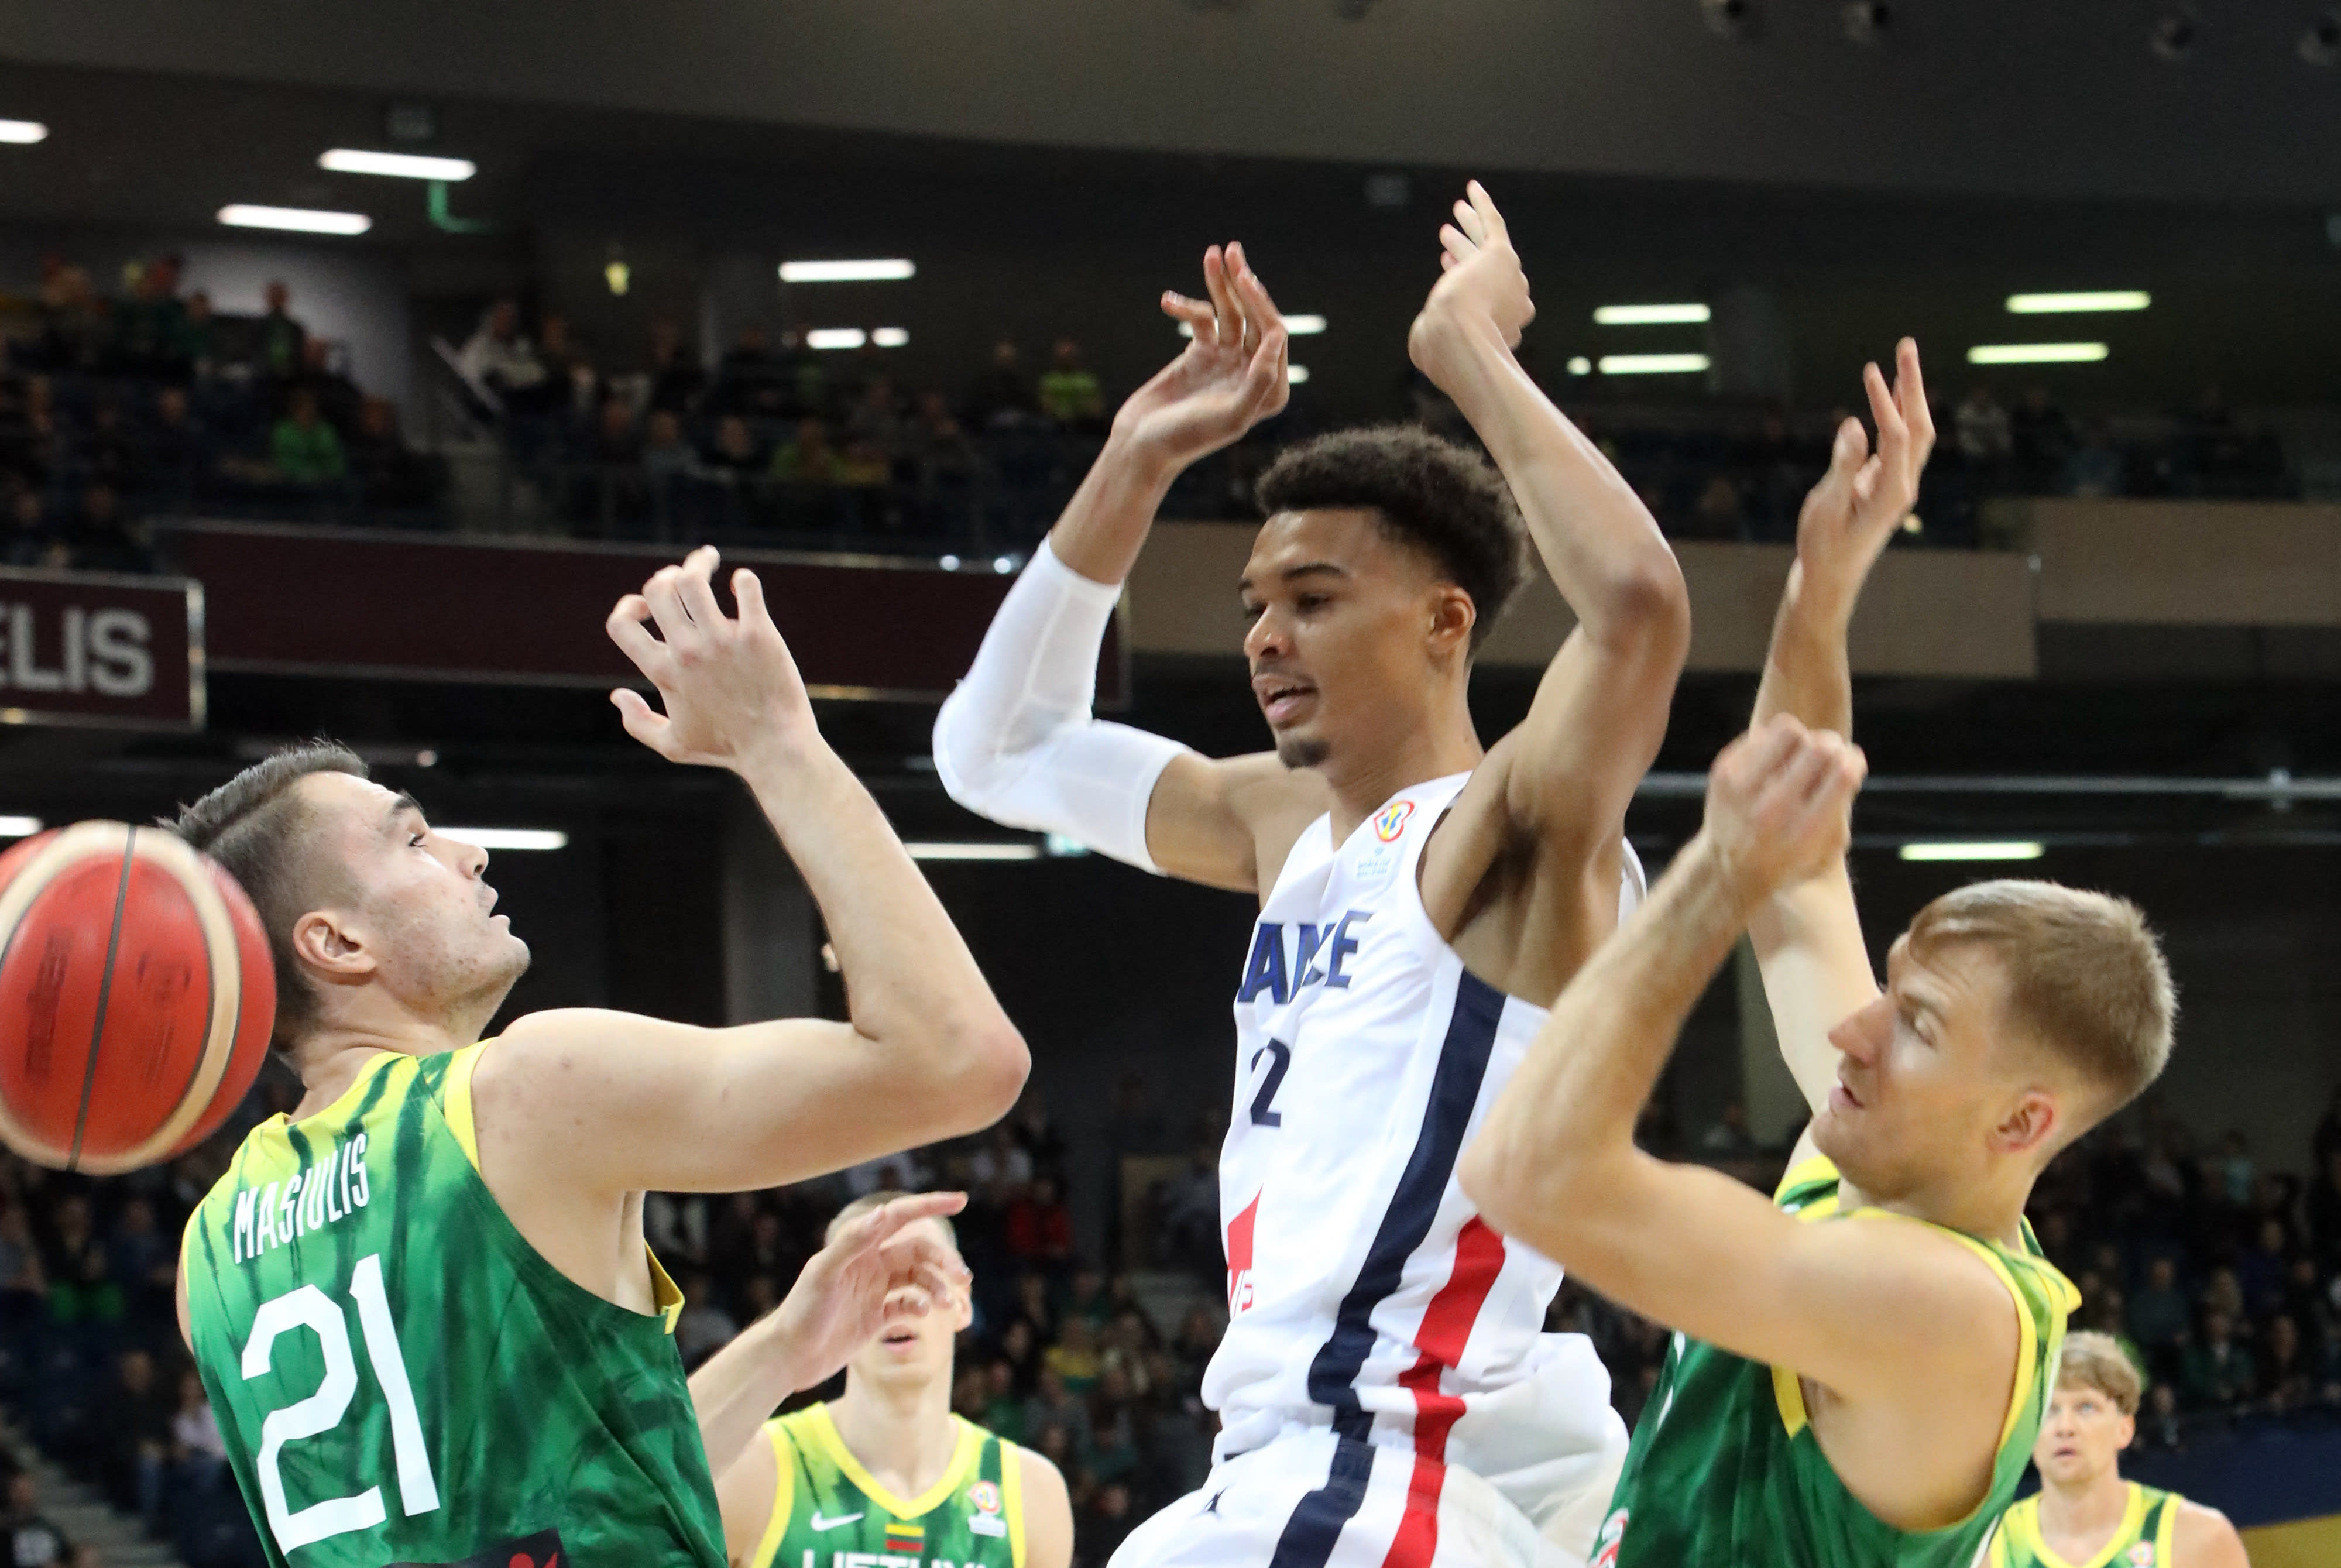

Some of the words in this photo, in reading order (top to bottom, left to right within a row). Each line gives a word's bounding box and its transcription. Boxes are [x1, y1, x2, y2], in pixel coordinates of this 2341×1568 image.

[0, 603, 153, 697] LIS
[235, 1133, 370, 1264] MASIULIS
[242, 1253, 440, 1556] 21
